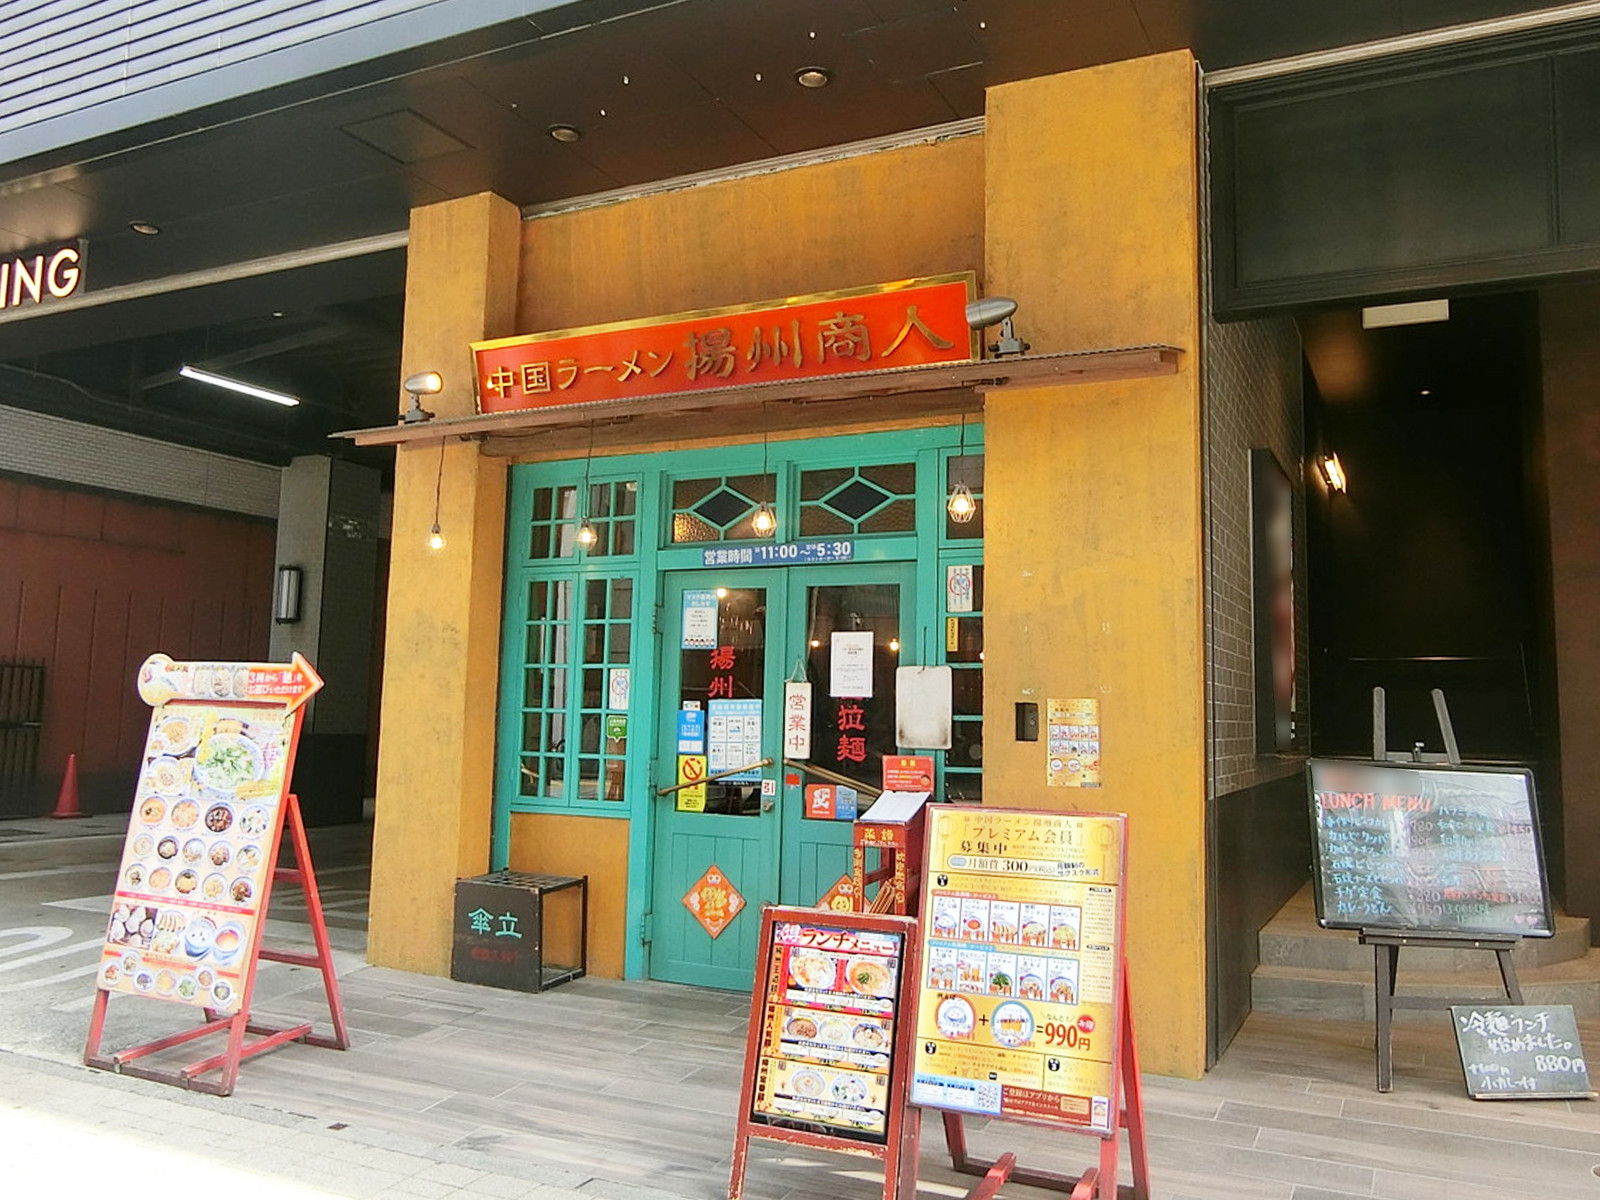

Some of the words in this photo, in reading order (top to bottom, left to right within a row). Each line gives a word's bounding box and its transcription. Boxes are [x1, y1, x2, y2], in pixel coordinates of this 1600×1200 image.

[704, 549, 752, 565] 営業時間
[789, 693, 806, 751] 営業中
[1320, 791, 1375, 809] LUNCH
[1381, 793, 1431, 812] MENU
[468, 908, 522, 938] 傘立
[801, 927, 893, 953] ランチメニュー
[1535, 1055, 1587, 1073] 880円
